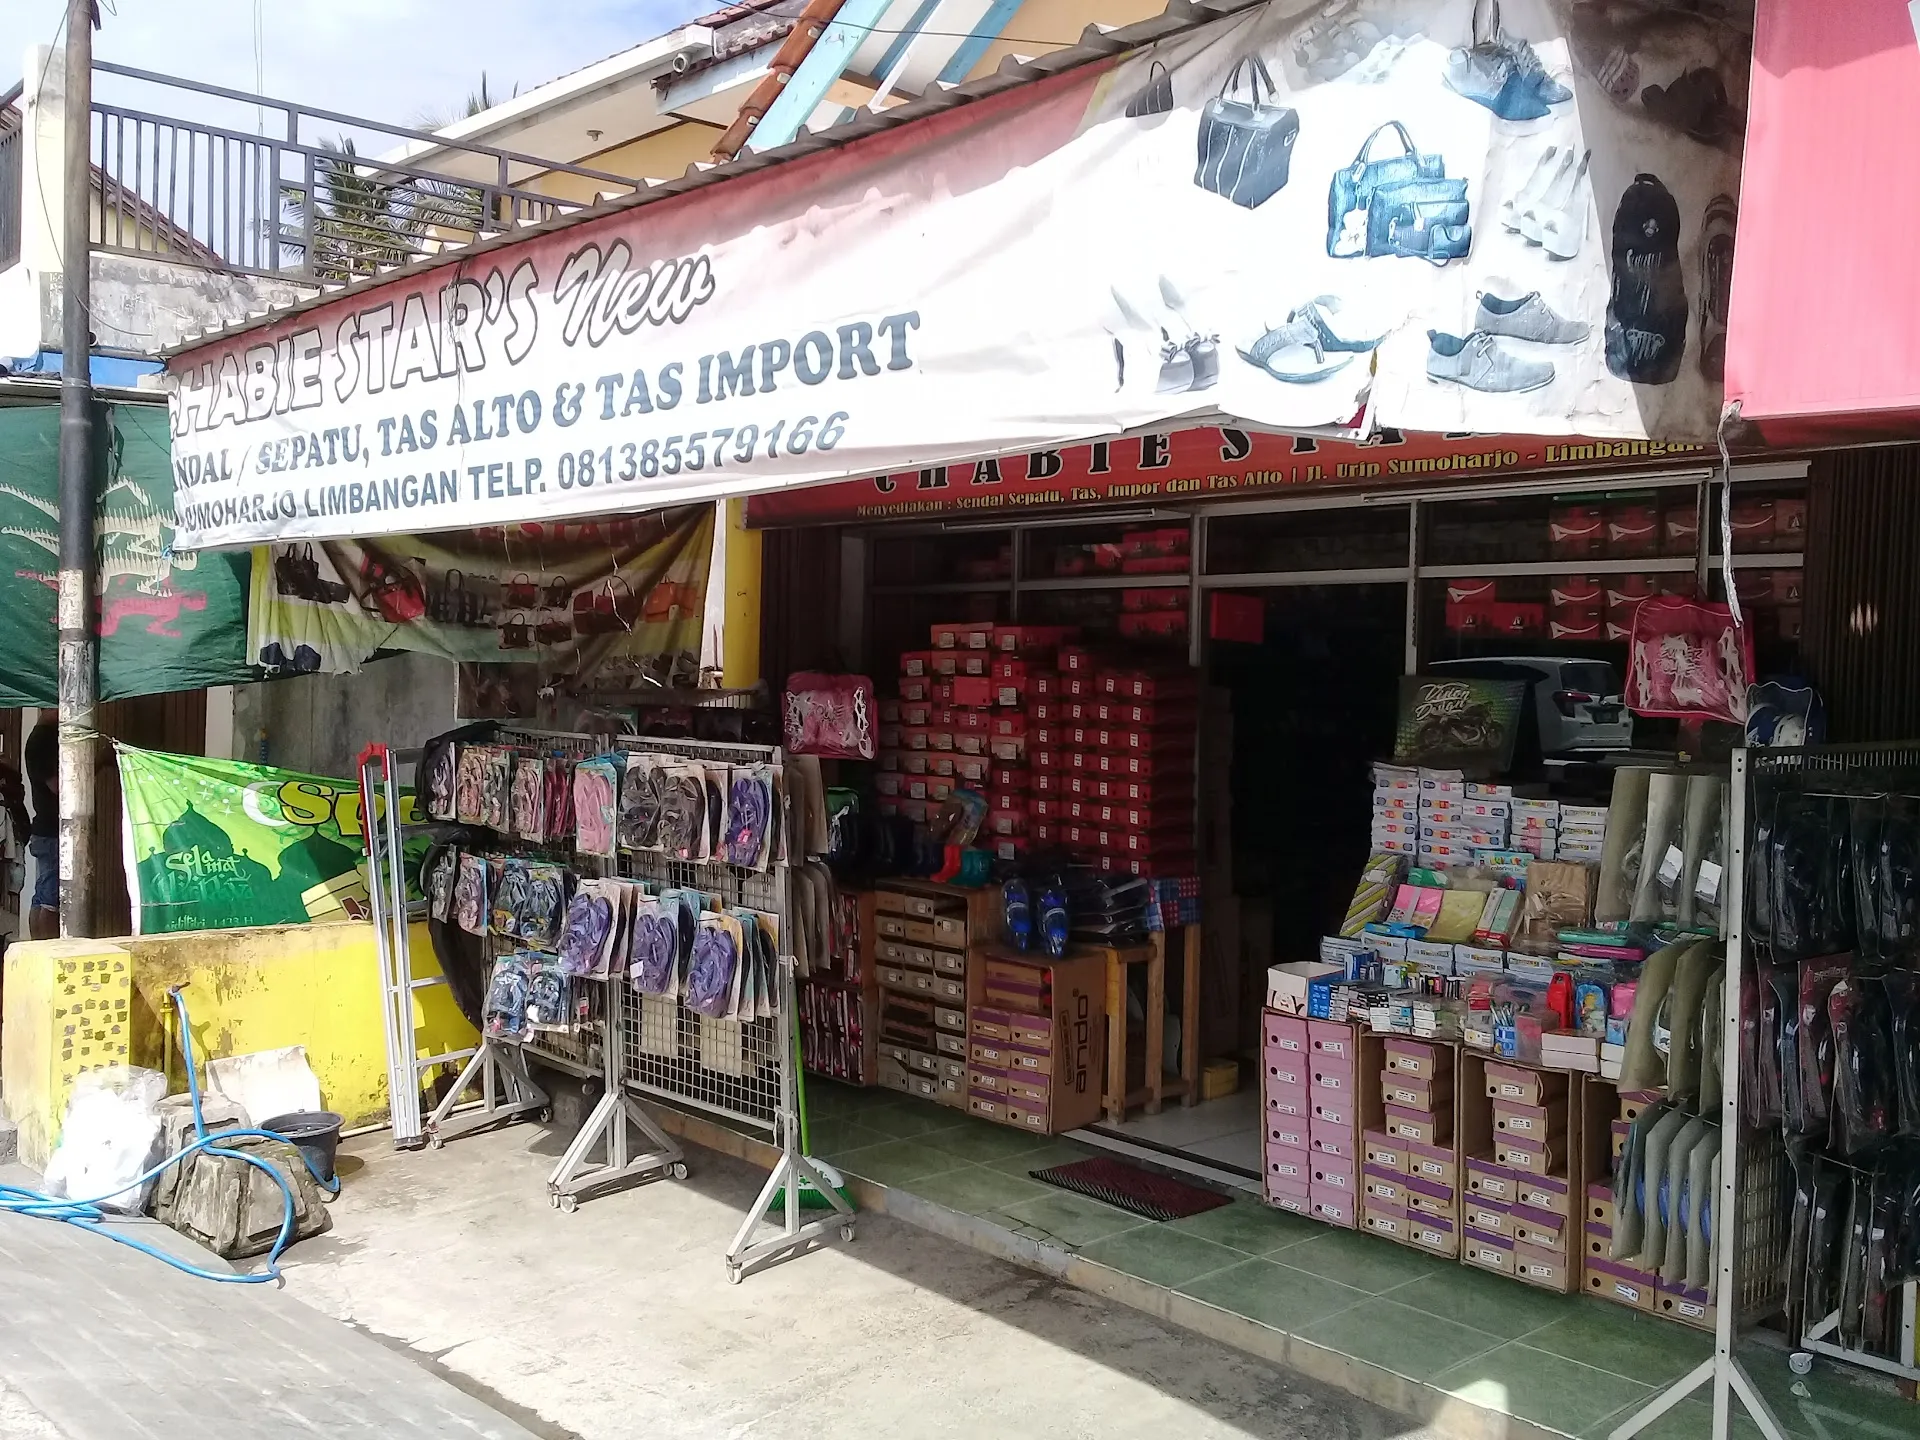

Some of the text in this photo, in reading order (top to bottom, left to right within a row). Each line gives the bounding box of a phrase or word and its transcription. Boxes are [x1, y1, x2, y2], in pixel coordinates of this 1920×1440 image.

[335, 256, 539, 403] STAR'S
[554, 237, 716, 348] New
[255, 423, 369, 475] SEPATU,
[377, 408, 438, 457] TAS
[446, 389, 542, 446] ALTO
[552, 381, 586, 428] &
[596, 362, 684, 421] TAS
[696, 310, 921, 404] IMPORT
[175, 411, 849, 533] UMOHARJO LIMBANGAN TELP. 081385579166
[857, 501, 943, 516] Menyediakan
[956, 493, 1004, 509] Sendal
[1008, 489, 1065, 507] Sepatu,
[1070, 487, 1101, 501] Tas,
[1107, 482, 1161, 498] Impor
[1166, 478, 1201, 493] dan
[1206, 474, 1238, 489] Tas
[1243, 470, 1282, 486] Alto
[1336, 461, 1381, 479] Urip
[1387, 449, 1519, 475] Sumoharjo
[165, 844, 251, 888] Selamat
